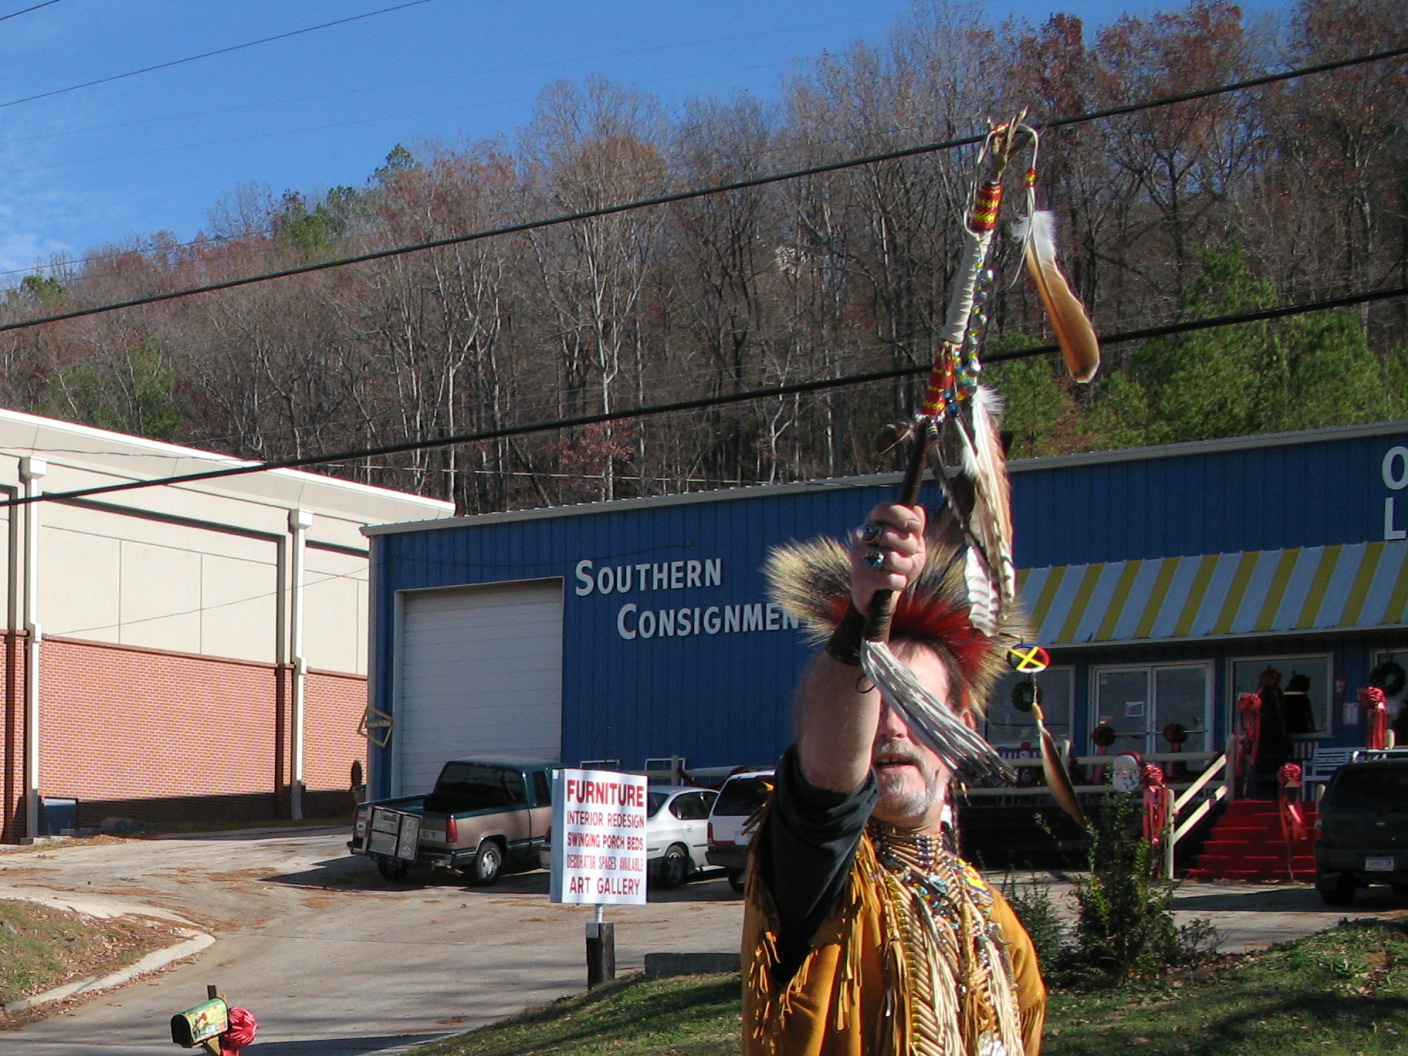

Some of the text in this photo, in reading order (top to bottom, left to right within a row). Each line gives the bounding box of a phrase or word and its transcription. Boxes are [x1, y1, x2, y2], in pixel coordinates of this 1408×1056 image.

[575, 559, 722, 597] SOUTHERN
[617, 603, 813, 640] CONSIGNMEN
[567, 779, 644, 808] FURNITURE
[567, 810, 644, 829] INTERIOR REDESIGN
[567, 831, 643, 851] SWINGING PORCH BEDS
[567, 854, 596, 869] DECORATOR
[620, 857, 643, 872] AVAILABLE
[569, 876, 640, 895] ART GALLERY
